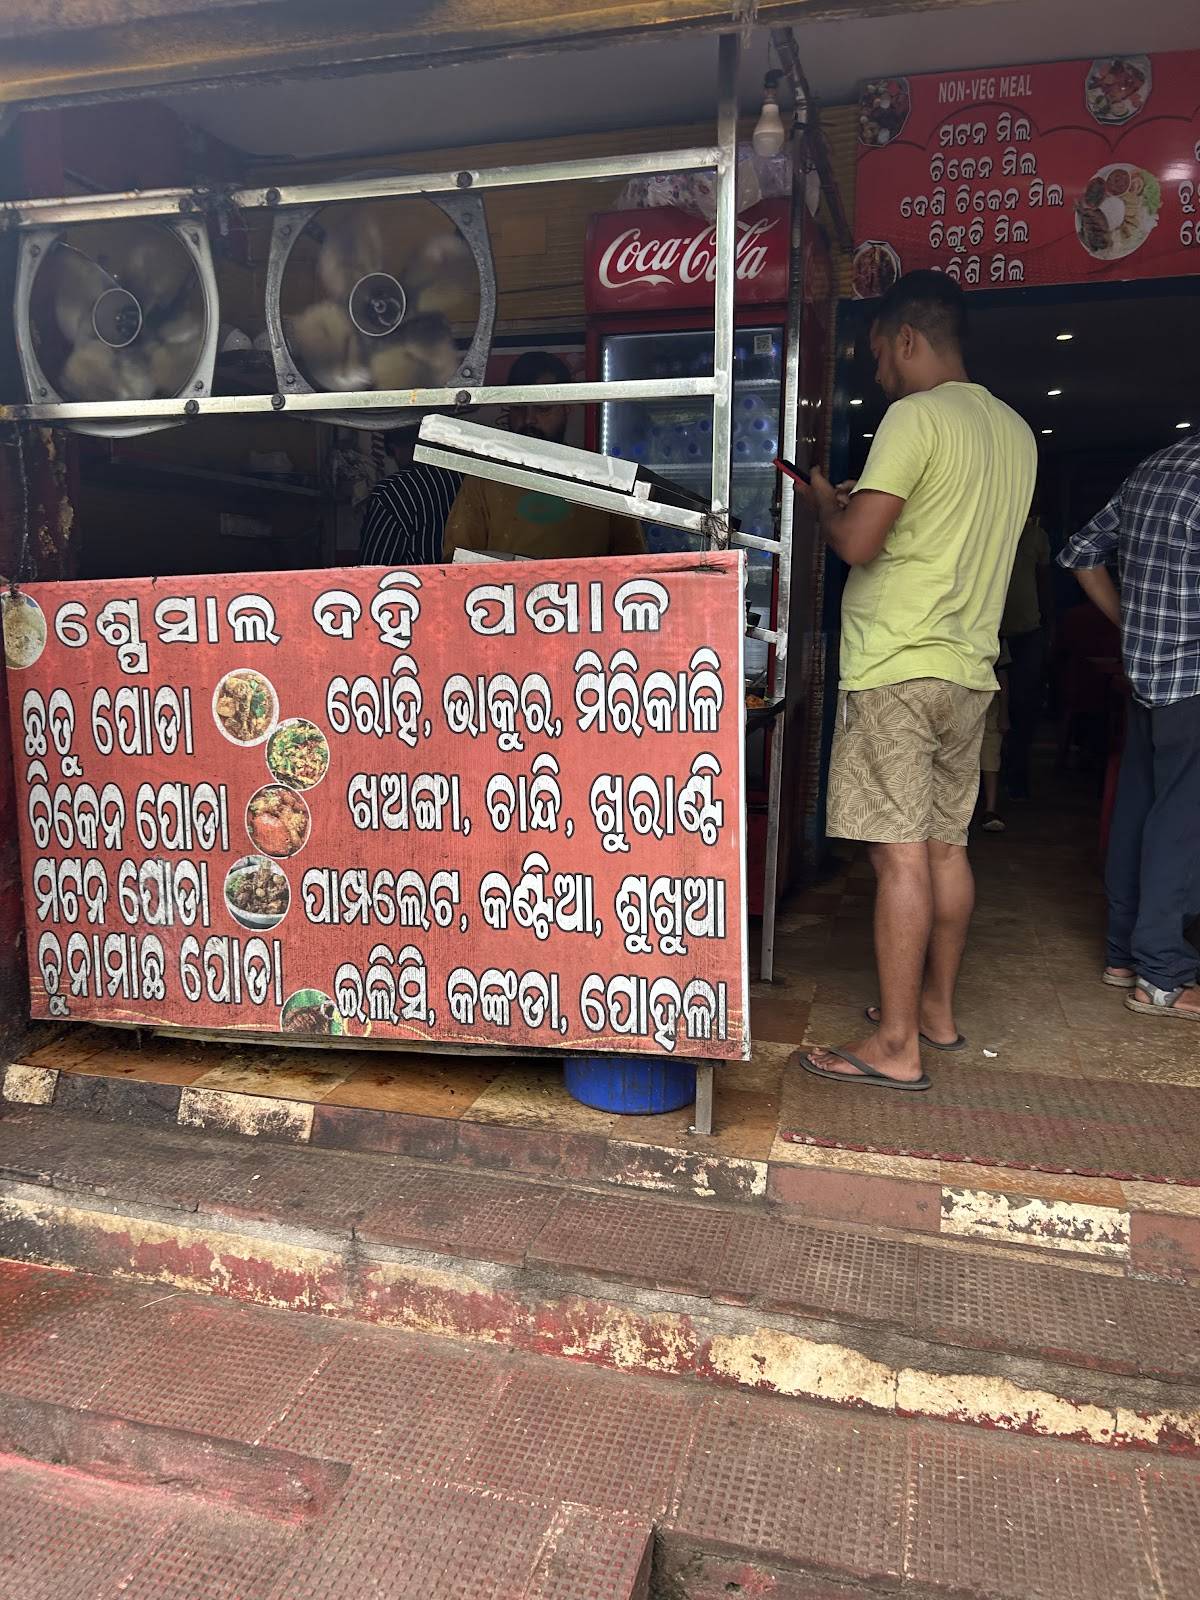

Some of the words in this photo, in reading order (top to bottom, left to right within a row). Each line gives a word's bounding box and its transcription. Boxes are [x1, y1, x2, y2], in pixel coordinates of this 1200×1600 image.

[938, 78, 996, 103] NON-VEG
[1000, 75, 1033, 98] MEAL
[930, 152, 993, 182] ଚିକେନ
[1002, 146, 1037, 176] ମିଲ
[940, 122, 988, 147] ମଟନ
[997, 112, 1031, 142] ମିଲ
[900, 186, 946, 218] ଦେଶି
[956, 184, 1019, 213] ଚିକେନ
[1029, 178, 1064, 207] ମିଲ
[994, 215, 1029, 243] ମିଲ
[990, 253, 1025, 282] ମିଲ
[312, 570, 423, 649] ଦହି
[464, 578, 671, 636] ପଖାଳ
[22, 688, 84, 778] ଛତୁ
[326, 653, 433, 749] ରୋହି,
[442, 672, 564, 752] ଭାକୁର,
[574, 646, 724, 738] ମିରିକାଳି
[26, 758, 127, 851] ଚିକେନ
[32, 857, 109, 926] ମଟନ
[614, 873, 727, 956] ଶୁଖୁଆ
[37, 930, 166, 1017] ଚୁନାମାଛ
[580, 971, 727, 1052] ପୋହଳା
